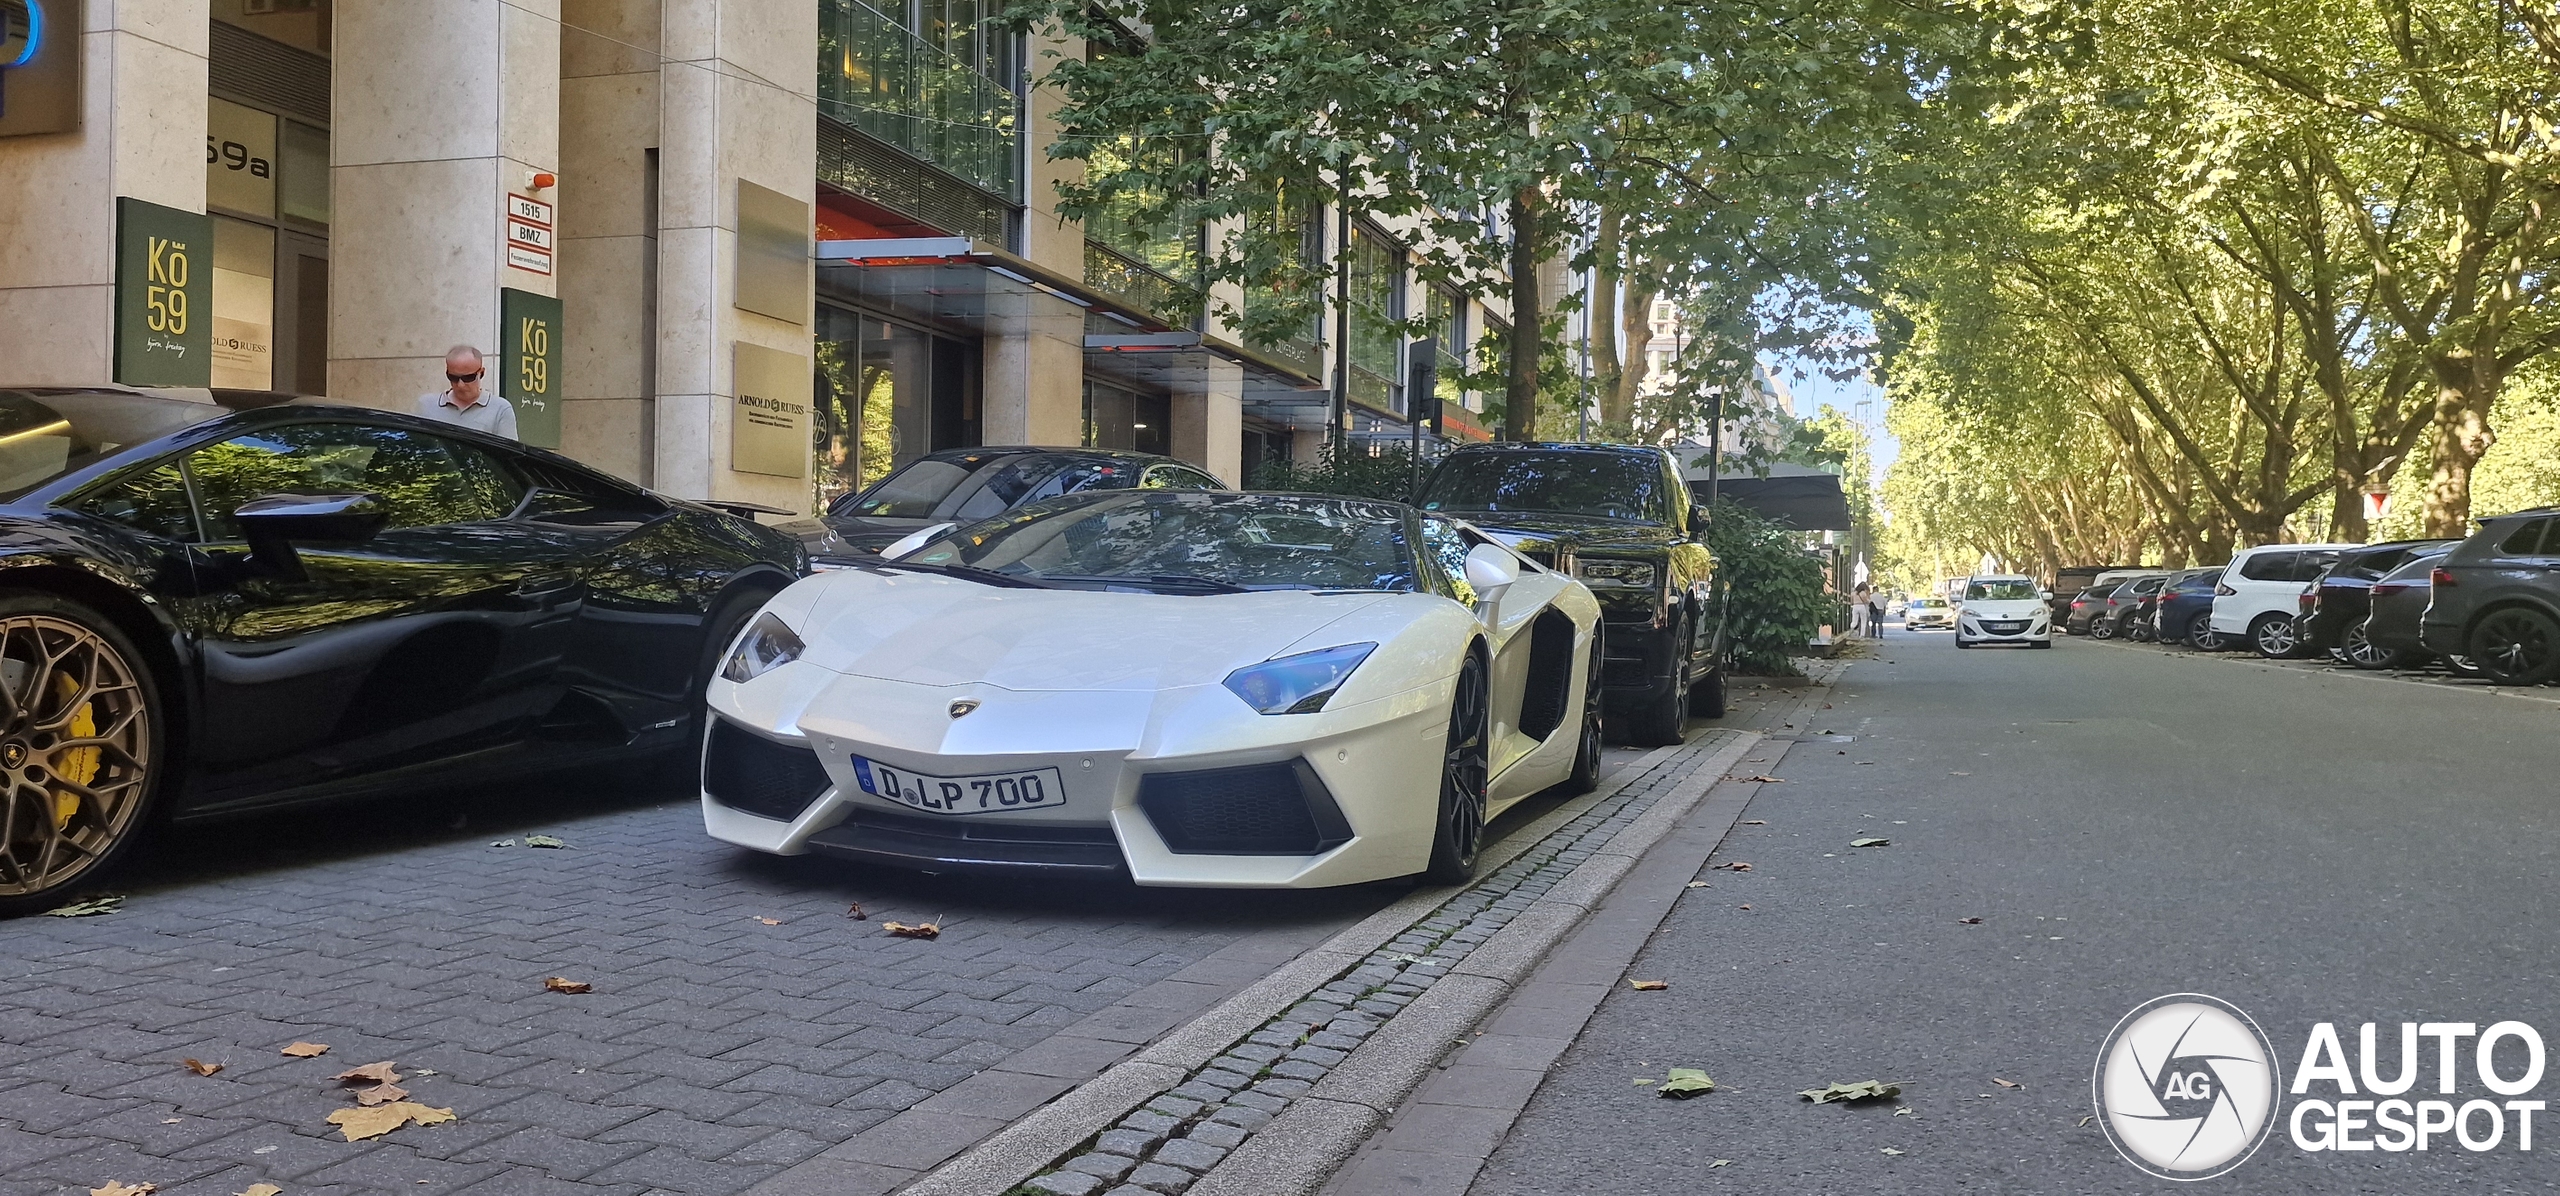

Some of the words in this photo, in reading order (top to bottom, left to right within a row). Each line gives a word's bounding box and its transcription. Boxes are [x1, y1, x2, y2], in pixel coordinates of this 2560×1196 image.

[520, 202, 541, 219] 1515
[519, 226, 541, 244] BMZ
[147, 285, 188, 335] 59
[240, 341, 267, 354] RUESS
[521, 355, 547, 394] 59
[738, 394, 770, 409] ARNOLD
[781, 402, 804, 415] RUESS
[879, 767, 901, 798] D
[916, 778, 963, 810] LP
[970, 775, 1045, 808] 700
